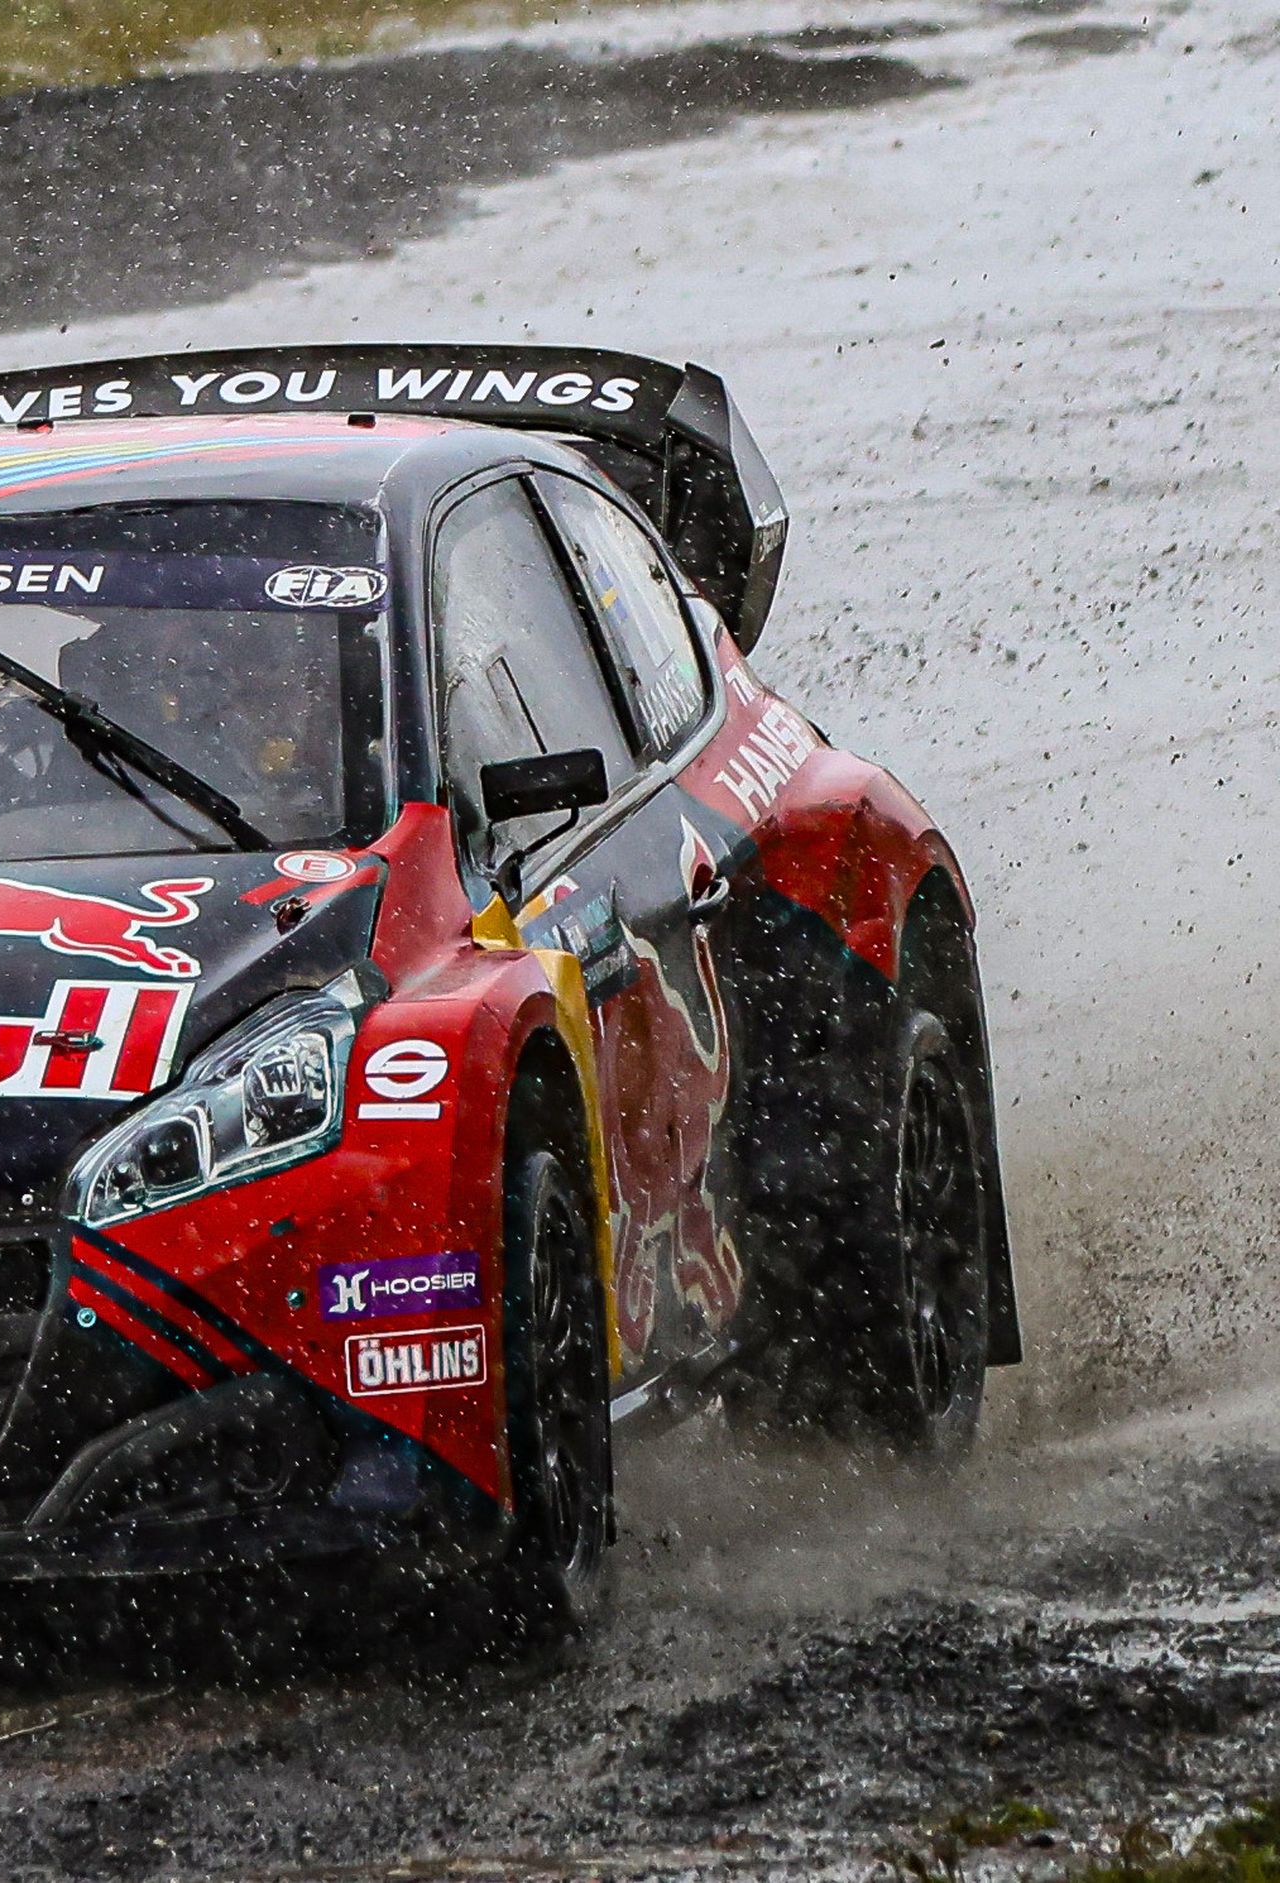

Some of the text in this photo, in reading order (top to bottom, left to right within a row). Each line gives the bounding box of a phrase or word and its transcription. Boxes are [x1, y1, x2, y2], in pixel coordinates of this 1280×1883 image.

[171, 369, 337, 405] YOU
[376, 367, 640, 412] WINGS
[269, 570, 378, 600] FIA
[371, 1271, 476, 1297] HOOSIER
[357, 1338, 479, 1387] ÖHLINS
